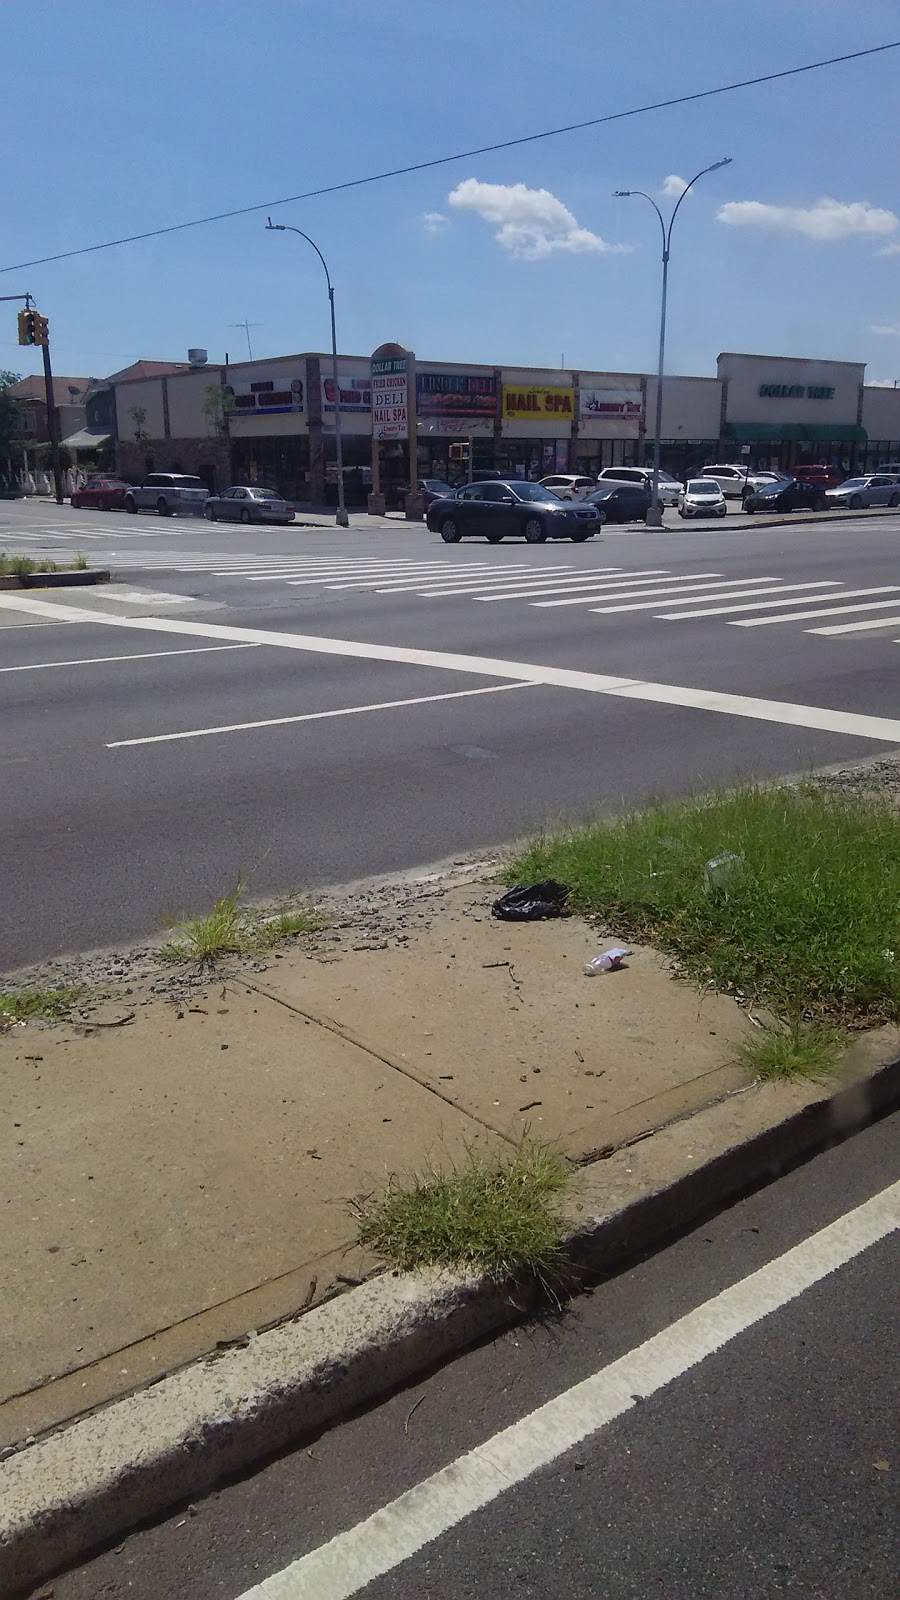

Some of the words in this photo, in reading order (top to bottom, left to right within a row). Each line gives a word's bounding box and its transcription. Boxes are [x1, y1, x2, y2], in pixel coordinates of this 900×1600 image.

[372, 361, 392, 373] DOLLAR
[393, 361, 406, 370] TREE
[759, 384, 805, 398] DOLLAR
[807, 386, 836, 399] TREE
[376, 393, 404, 405] DELI
[506, 393, 541, 411] NAIL
[545, 394, 572, 412] SPA
[374, 409, 391, 422] NAIL
[392, 408, 407, 421] SPA
